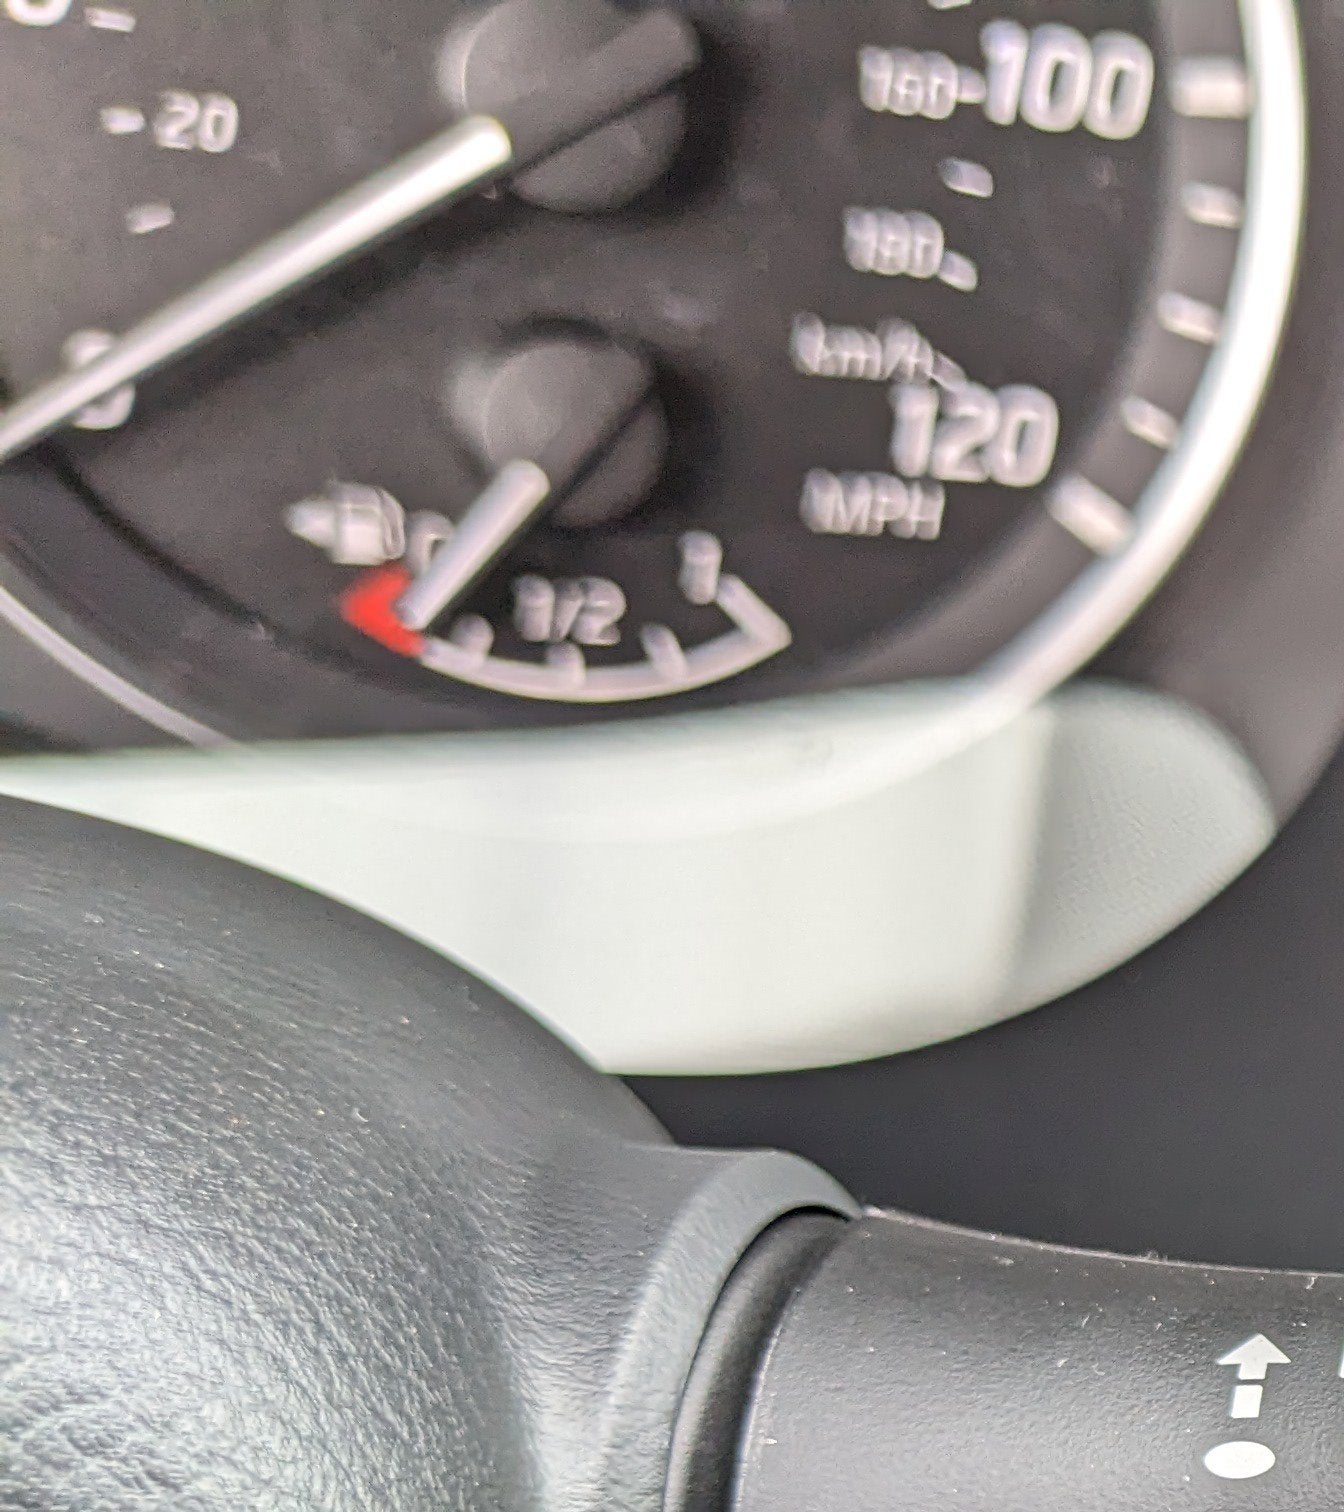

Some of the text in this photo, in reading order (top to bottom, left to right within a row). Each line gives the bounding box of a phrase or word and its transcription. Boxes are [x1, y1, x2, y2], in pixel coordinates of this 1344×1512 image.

[150, 87, 239, 152] 20
[979, 18, 1153, 140] 100
[888, 380, 1059, 488] 120
[800, 466, 946, 540] MPH
